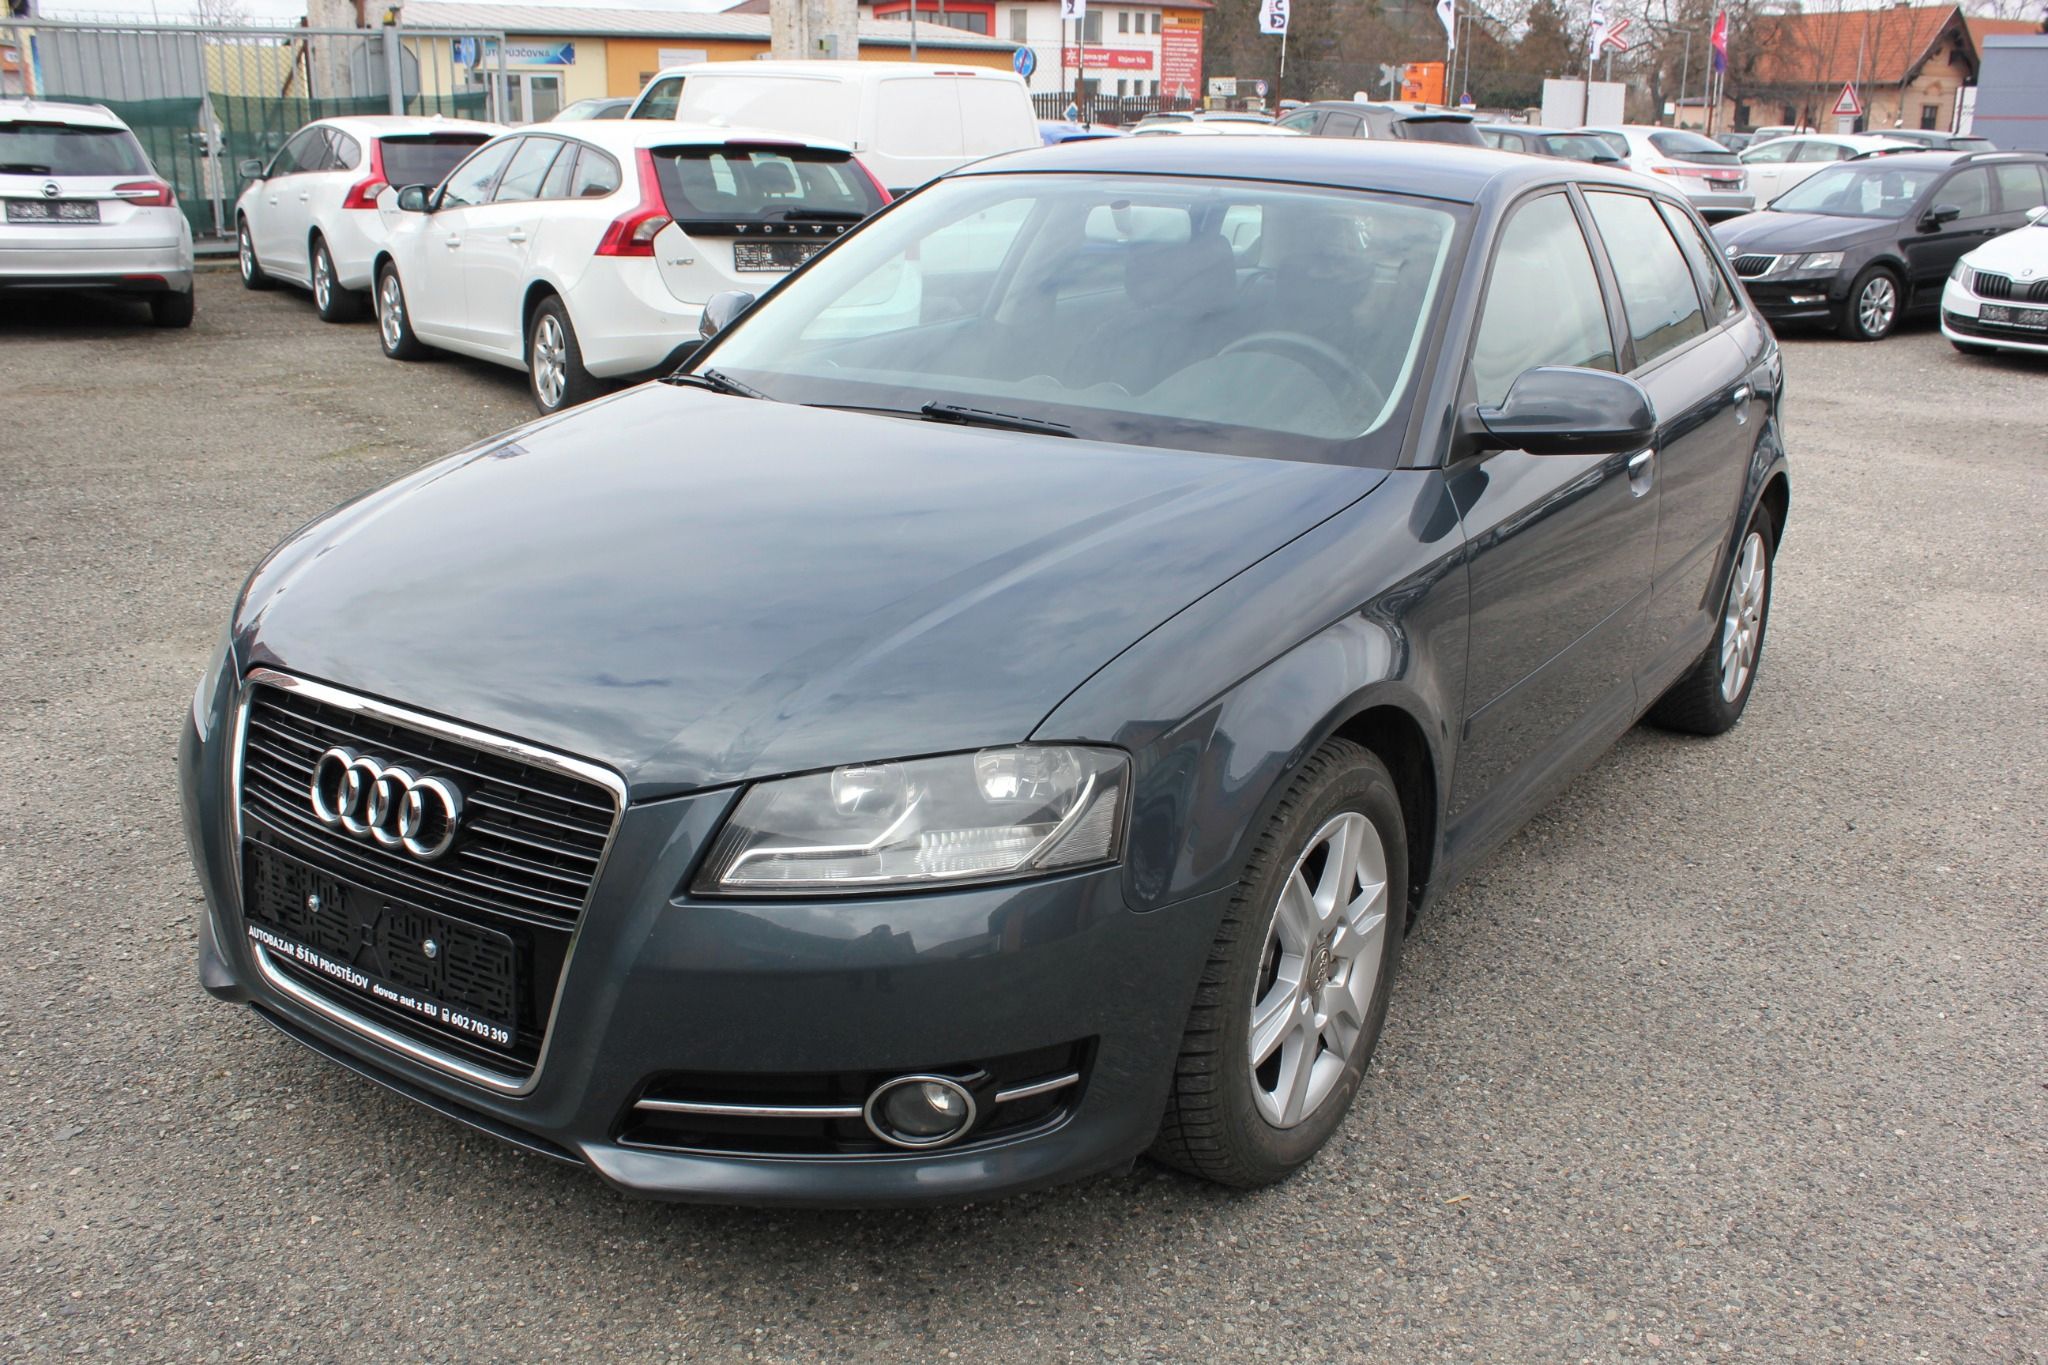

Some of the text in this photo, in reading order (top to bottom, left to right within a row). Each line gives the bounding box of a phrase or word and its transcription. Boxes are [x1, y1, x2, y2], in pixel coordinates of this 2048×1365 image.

[735, 224, 845, 234] VOLVO
[248, 925, 509, 1044] AUTOBAZAR ŠÍN PROSTĚJOV dovoz aut z EU 602 703 319
